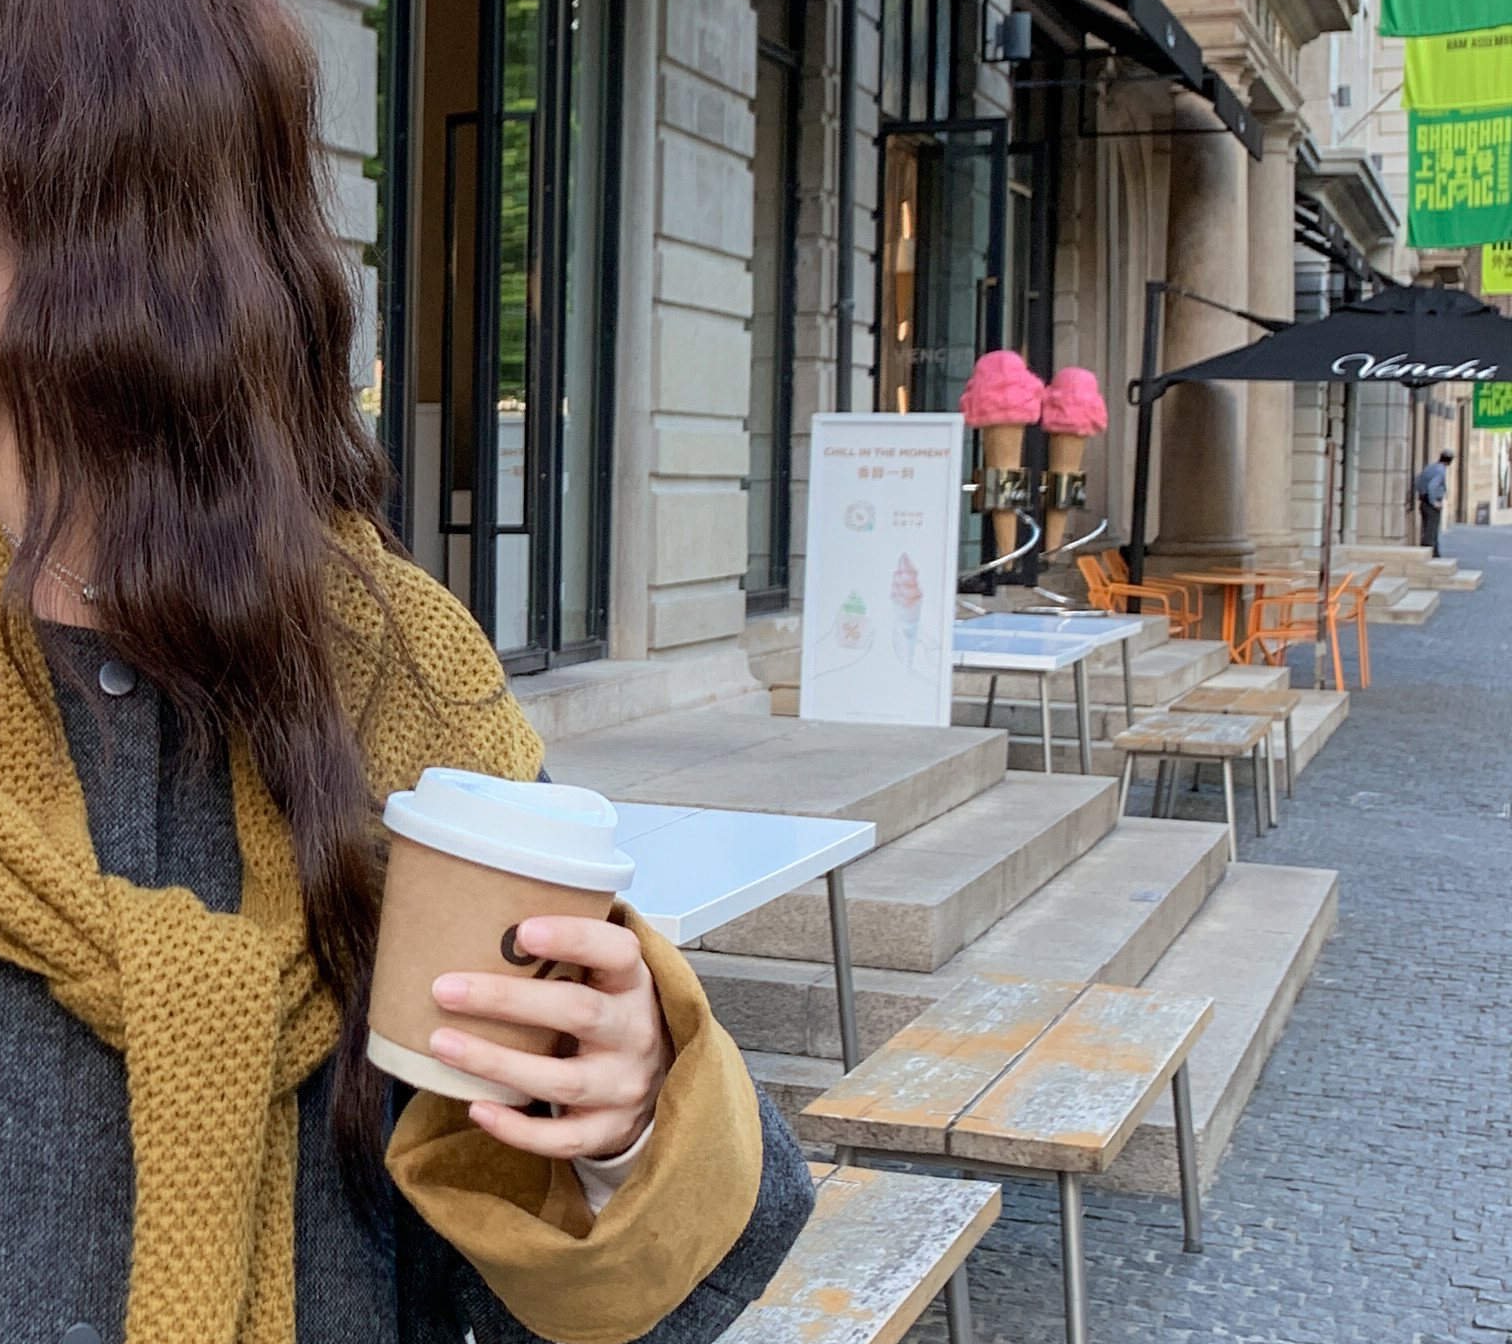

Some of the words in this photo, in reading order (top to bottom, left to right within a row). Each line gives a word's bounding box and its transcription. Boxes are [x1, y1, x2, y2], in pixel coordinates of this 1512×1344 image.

[1416, 116, 1511, 154] SHANGHAI
[824, 446, 857, 457] CHILL
[859, 447, 871, 457] IN
[874, 447, 896, 457] THE
[899, 447, 951, 458] MOMENT
